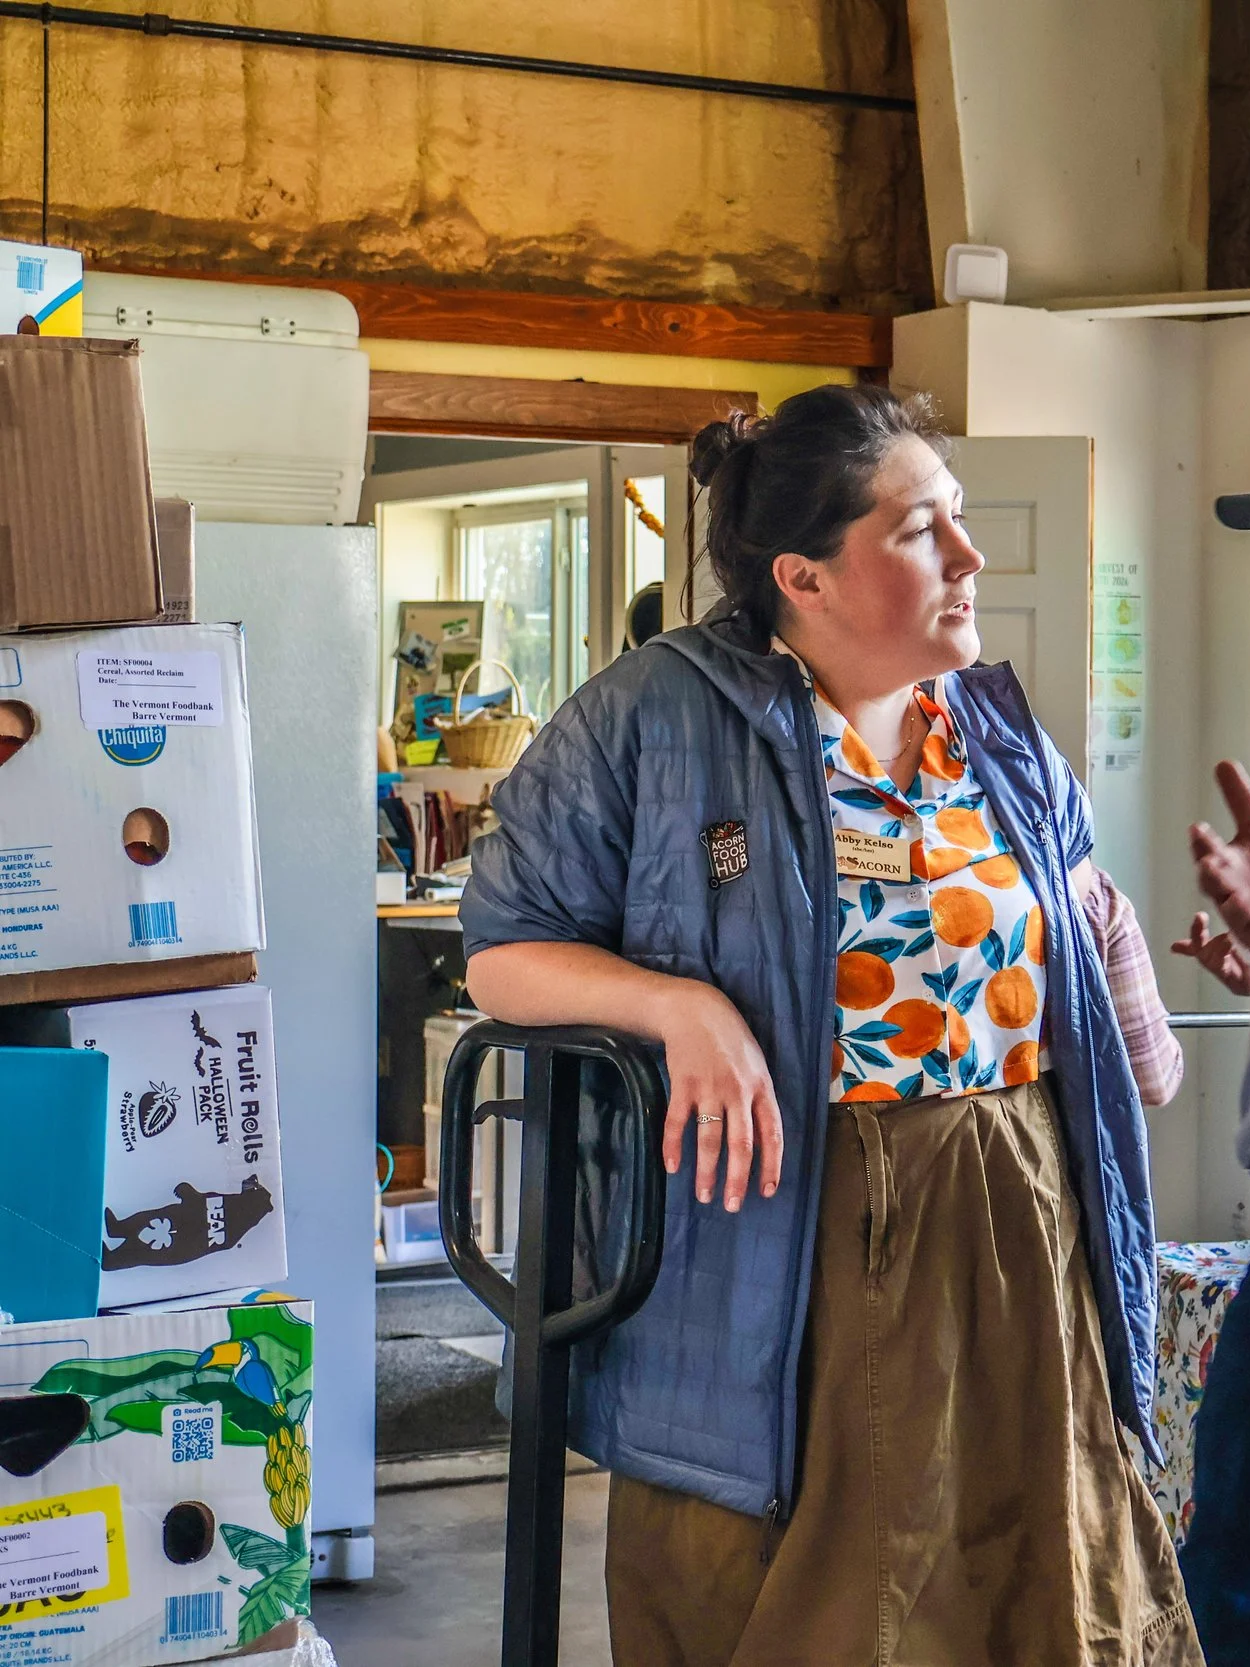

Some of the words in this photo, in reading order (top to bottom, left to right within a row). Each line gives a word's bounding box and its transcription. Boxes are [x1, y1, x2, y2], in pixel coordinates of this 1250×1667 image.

[97, 658, 121, 666] ITEM:
[97, 667, 124, 676] Cereal,
[125, 668, 155, 676] Assorted
[156, 669, 184, 677] Reclaim
[112, 700, 130, 708] The
[132, 700, 170, 709] Vermont
[172, 701, 214, 711] Foodbank
[132, 712, 157, 720] Barre
[159, 712, 196, 721] Vermont
[102, 727, 163, 749] Chiquita
[712, 833, 745, 850] ACORN
[835, 834, 861, 846] Abby
[864, 838, 894, 849] Kelso
[713, 843, 746, 862] FOOD
[2, 862, 33, 870] AMERICA
[715, 853, 748, 878] HUB
[858, 861, 901, 874] ACORN
[2, 923, 43, 933] HONDURAS
[237, 1031, 261, 1093] Fruit
[199, 1086, 213, 1122] PACK
[208, 1057, 229, 1144] HALLOWEEN
[120, 1091, 135, 1152] Strawberry
[241, 1100, 263, 1164] Rolls
[206, 1196, 226, 1247] BEAR
[10, 1574, 51, 1586] Vermont
[53, 1565, 99, 1580] Foodbank
[10, 1590, 37, 1600] Barre
[39, 1582, 80, 1594] Vermont
[38, 1625, 86, 1637] GUATEMALA
